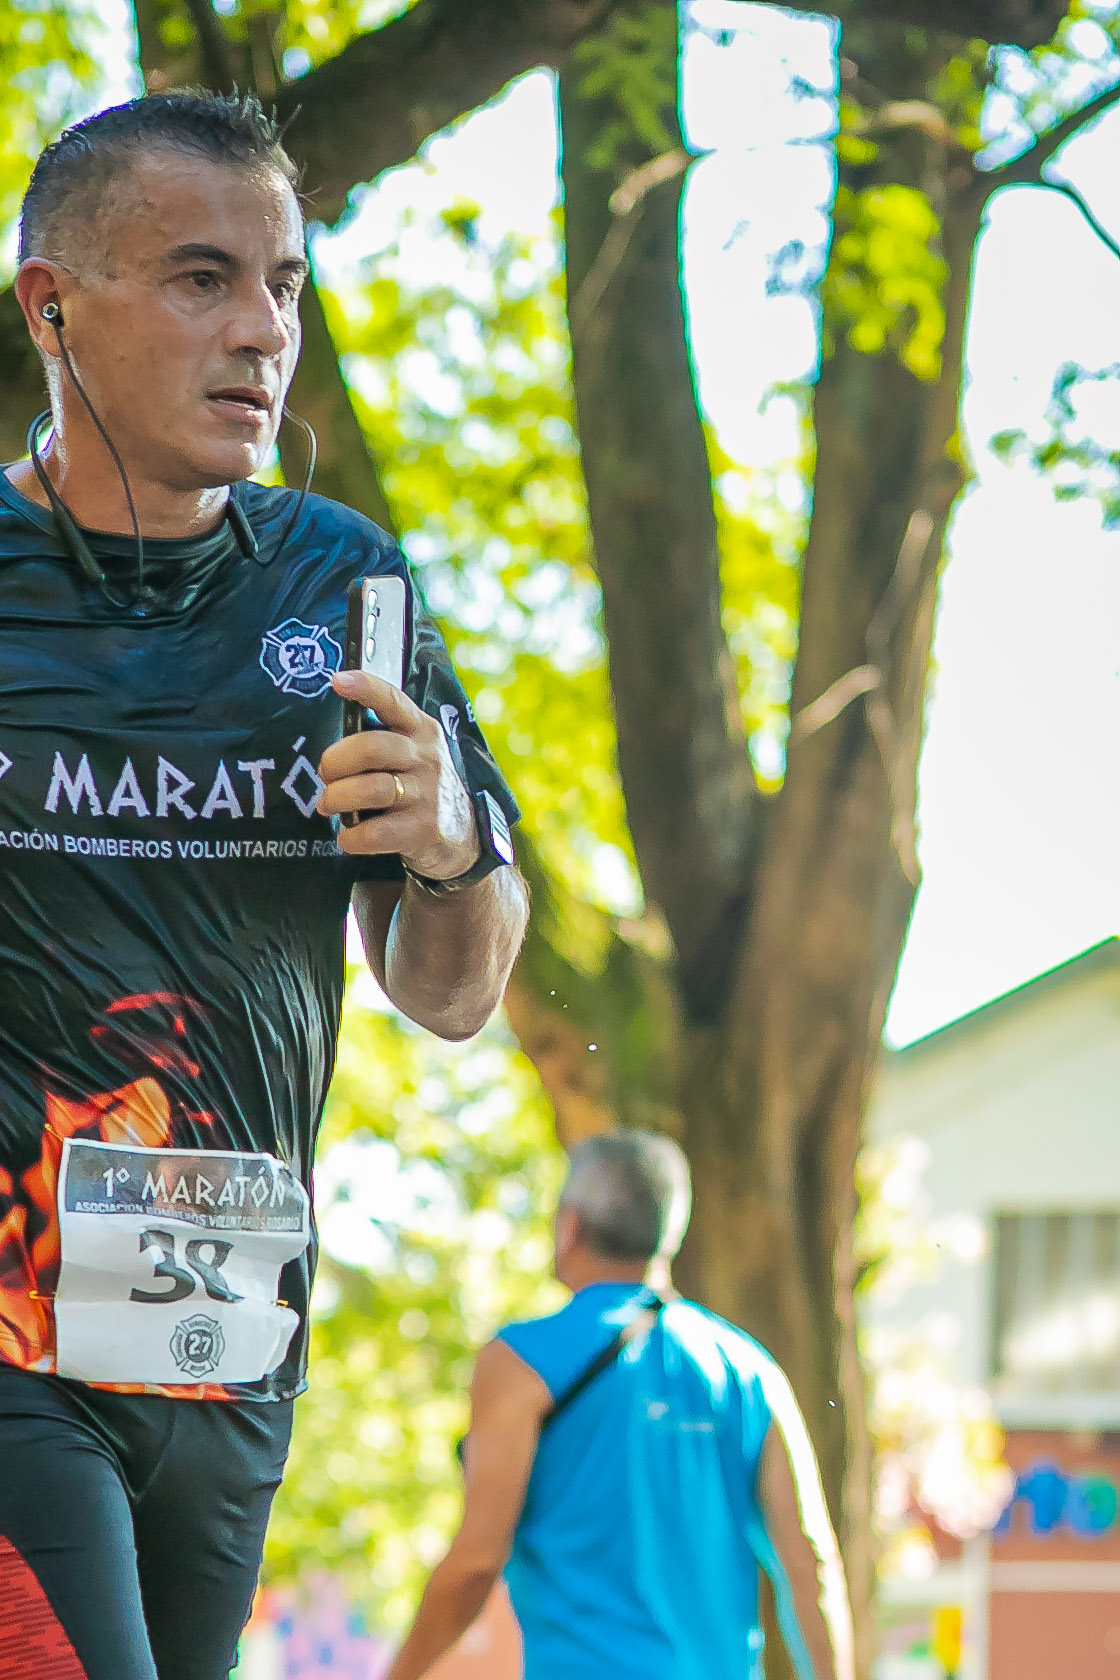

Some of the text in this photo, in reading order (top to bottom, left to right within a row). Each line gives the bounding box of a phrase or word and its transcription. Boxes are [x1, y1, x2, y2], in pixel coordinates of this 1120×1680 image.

[285, 643, 316, 669] 27
[44, 735, 327, 820] MARATÓ
[63, 835, 172, 858] BOMBEROS
[177, 840, 308, 858] VOLUNTARIOS
[311, 840, 343, 857] RO
[141, 1166, 285, 1208] MARATÓN
[129, 1226, 244, 1304] 38
[188, 1333, 212, 1356] 27
